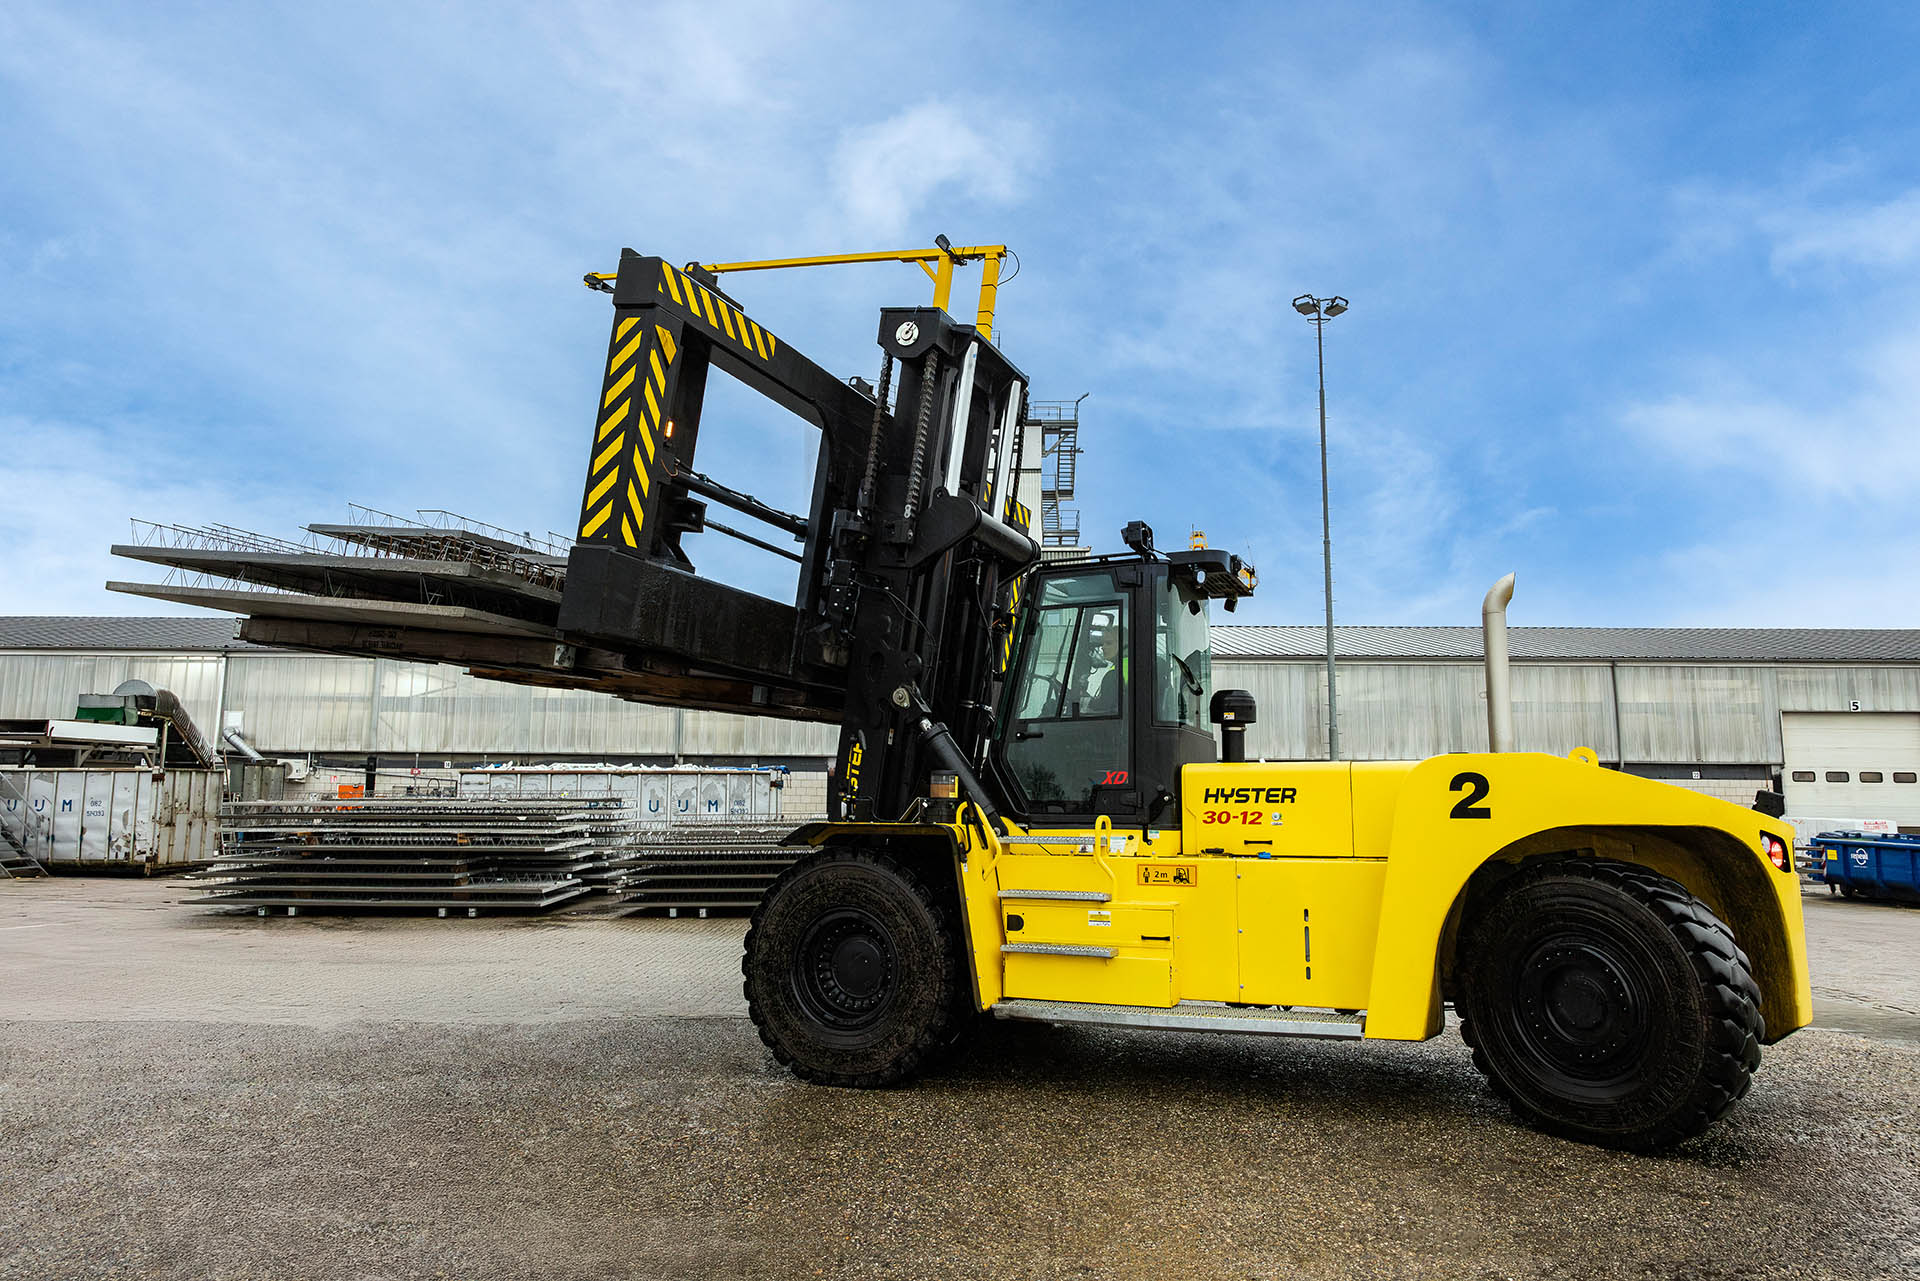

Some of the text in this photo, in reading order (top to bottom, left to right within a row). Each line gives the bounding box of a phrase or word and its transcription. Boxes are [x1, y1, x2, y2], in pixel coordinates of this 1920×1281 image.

[1852, 701, 1859, 711] 5
[1101, 771, 1128, 785] XD
[1203, 787, 1297, 804] HYSTER
[1449, 772, 1491, 819] 2
[1202, 811, 1263, 825] 30-12
